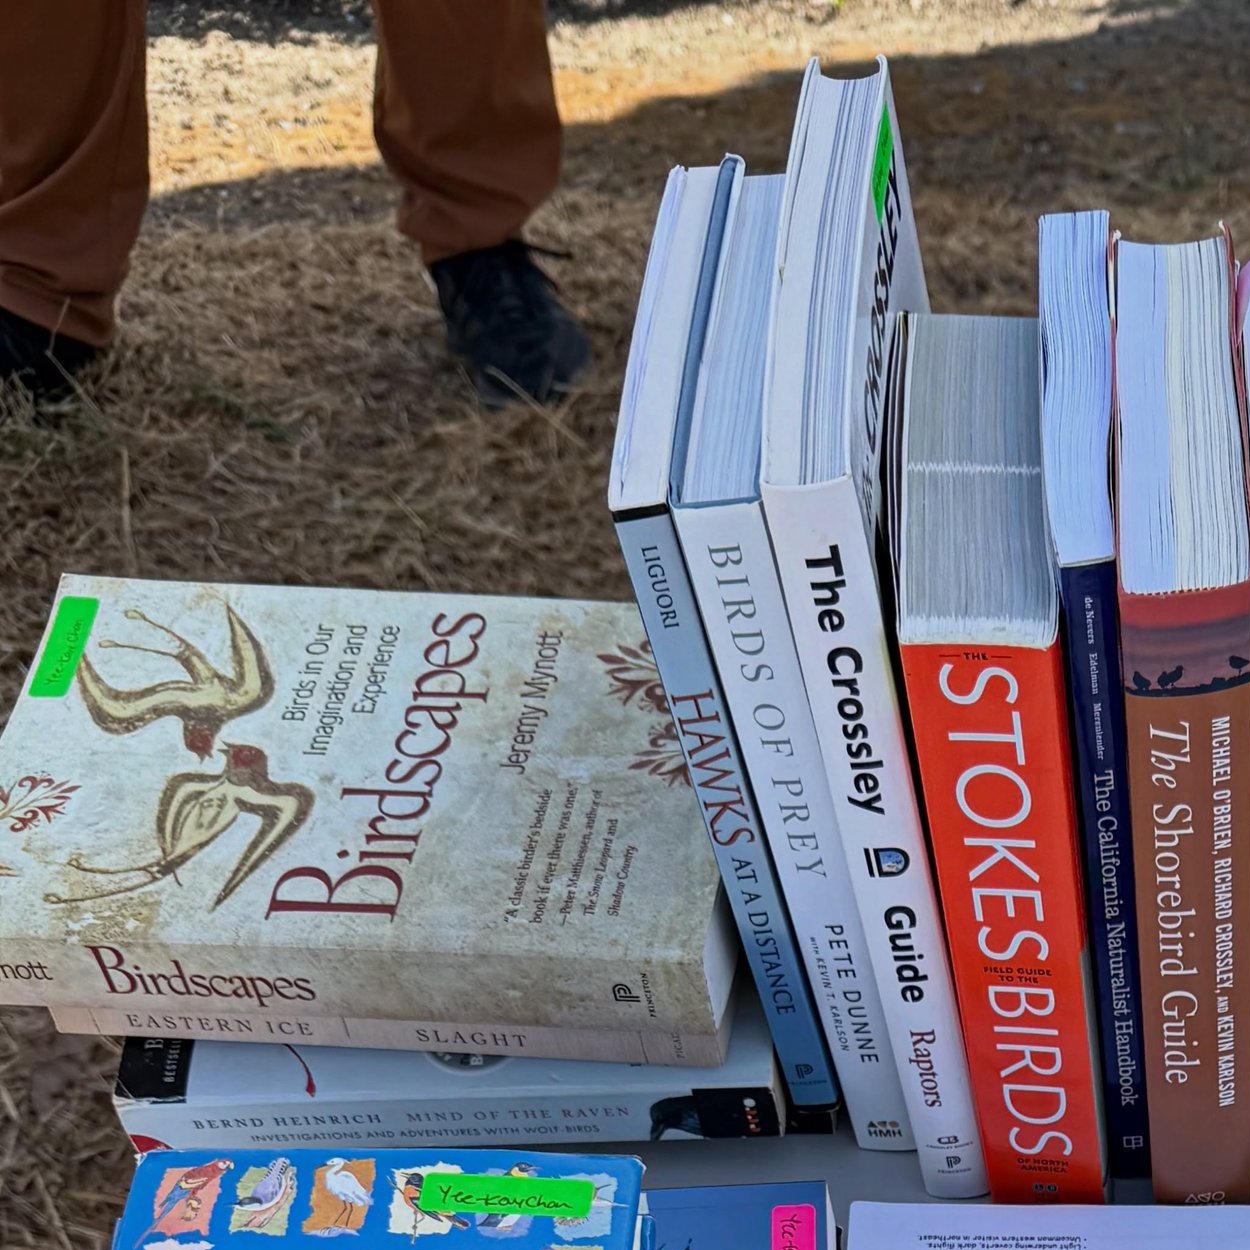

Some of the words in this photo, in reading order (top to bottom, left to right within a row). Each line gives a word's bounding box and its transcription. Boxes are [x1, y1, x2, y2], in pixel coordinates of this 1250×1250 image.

[641, 546, 679, 629] LIGUORI
[707, 542, 773, 682] BIRDS
[304, 661, 325, 676] in
[306, 624, 336, 656] Our
[352, 625, 400, 715] Experience
[520, 630, 564, 700] Mynott
[805, 544, 846, 632] The
[827, 646, 885, 815] Crossley
[963, 652, 988, 661] THE
[282, 681, 316, 722] Birds
[303, 662, 356, 756] Imagination
[350, 624, 368, 655] and
[753, 703, 794, 758] OF
[264, 611, 490, 923] Birdscapes
[500, 703, 549, 775] Jeremy
[671, 688, 754, 847] HAWKS
[1150, 721, 1191, 789] The
[772, 777, 827, 878] PREY
[938, 663, 1049, 961] STOKES
[1094, 770, 1113, 811] The
[731, 857, 758, 883] AT
[741, 889, 761, 905] A
[1097, 814, 1124, 918] California
[1152, 804, 1198, 977] Shorebird
[86, 945, 316, 1007] Birdscapes
[748, 911, 796, 1015] DISTANCE
[883, 905, 928, 1003] Guide
[1107, 922, 1132, 1017] Naturalist
[125, 1013, 253, 1033] EASTERN
[265, 1020, 313, 1036] ICE
[416, 1027, 527, 1048] SLAGHT
[909, 1028, 942, 1108] Raptors
[988, 985, 1073, 1158] BIRDS
[1115, 1020, 1138, 1106] Handbook
[1161, 990, 1200, 1085] Guide
[193, 1116, 265, 1131] BERND
[273, 1113, 382, 1127] HEINRICH
[407, 1111, 463, 1123] MIND
[474, 1110, 499, 1121] OF
[508, 1109, 552, 1120] THE
[561, 1106, 630, 1120] RAVEN
